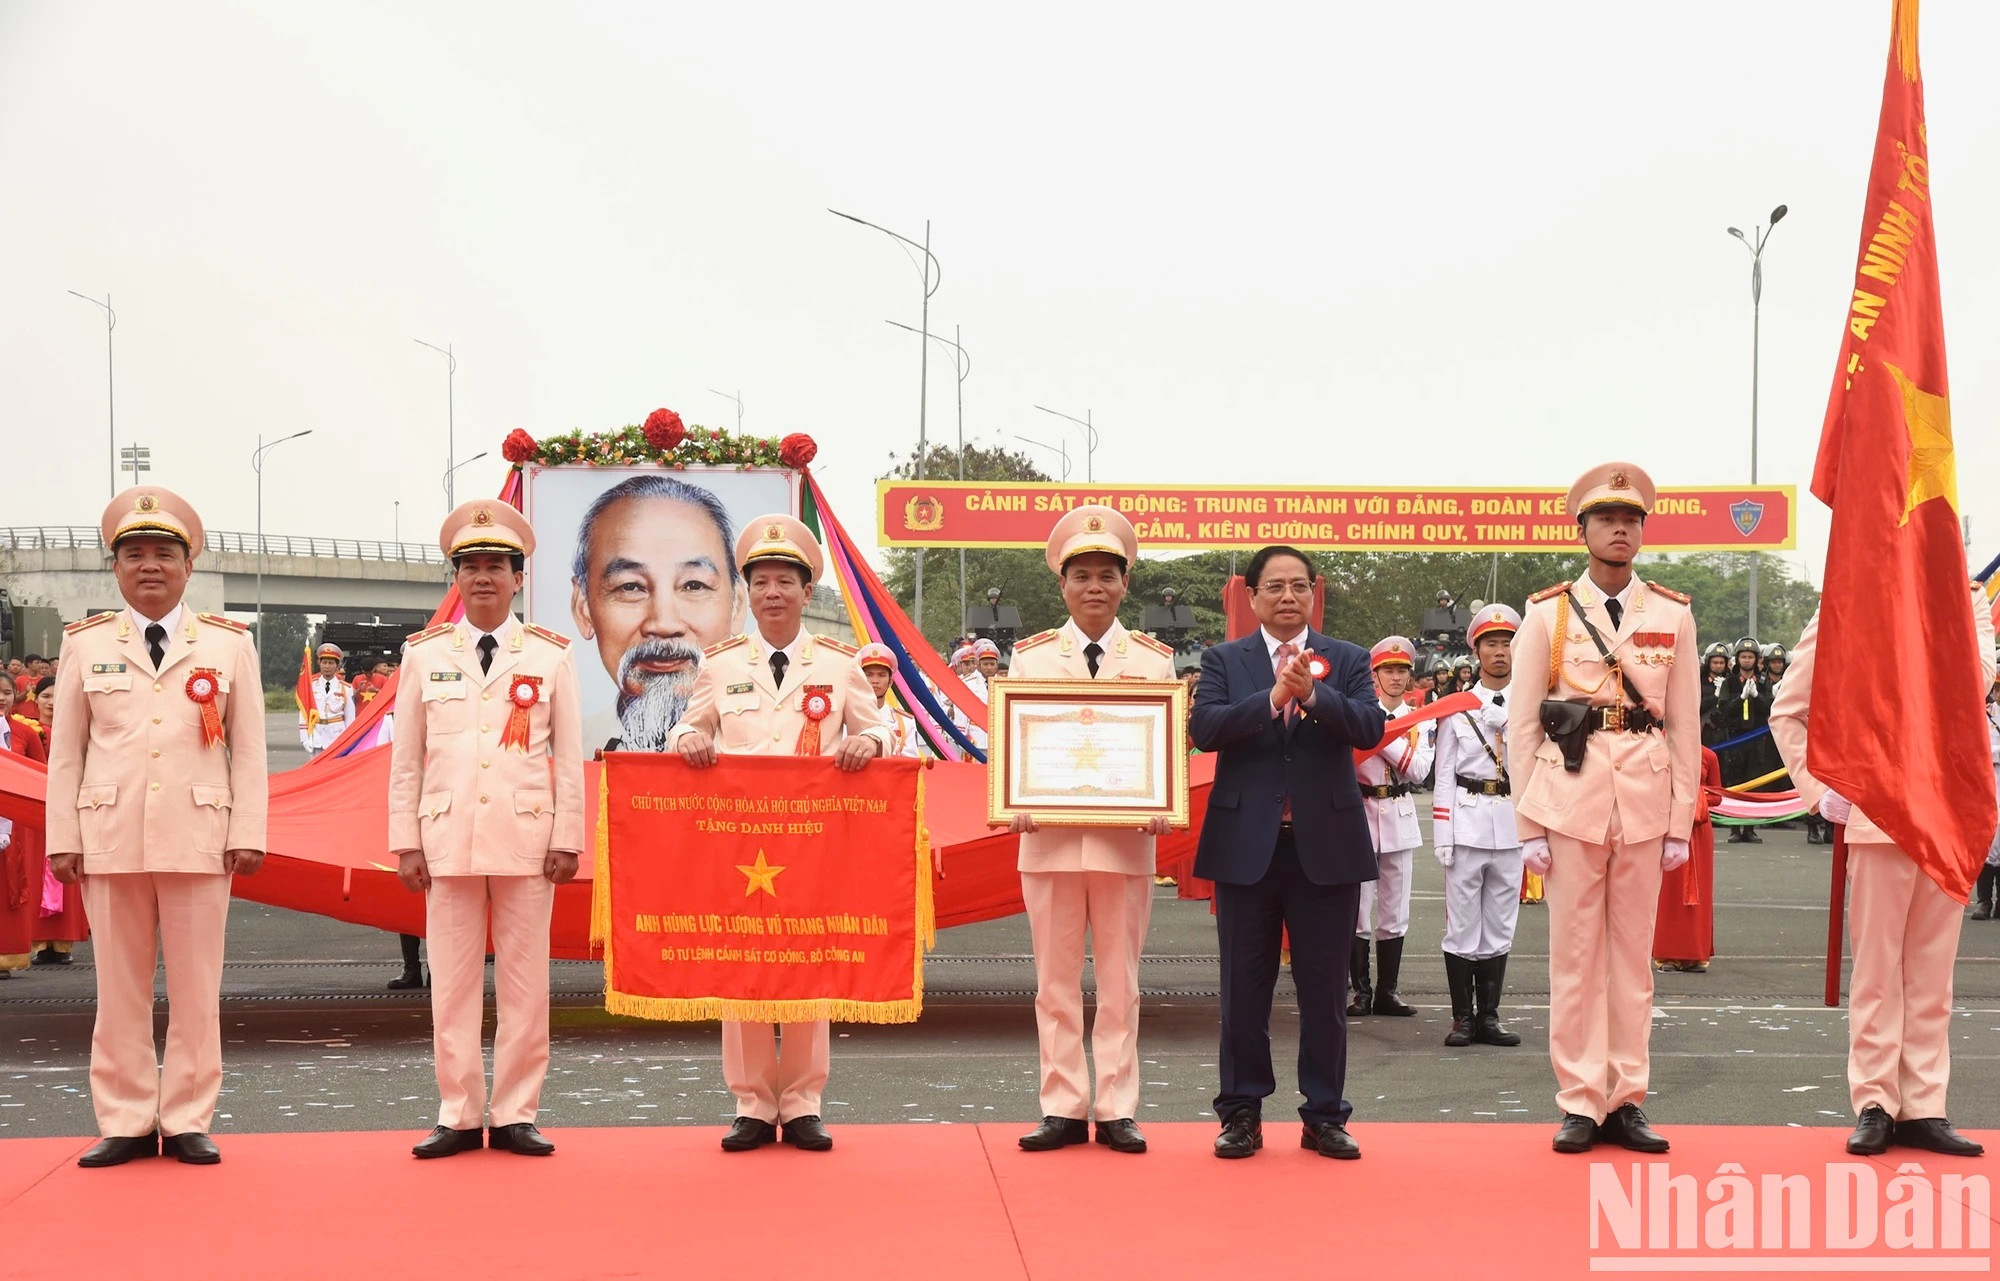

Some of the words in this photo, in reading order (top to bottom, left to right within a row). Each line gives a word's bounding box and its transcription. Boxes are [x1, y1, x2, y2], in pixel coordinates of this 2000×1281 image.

[1860, 200, 1919, 286] NINH
[1851, 289, 1887, 341] AN
[965, 491, 1026, 511] CẢNH
[1034, 493, 1076, 511] SÁT
[1119, 494, 1187, 515] ĐỘNG:
[1194, 497, 1267, 513] TRUNG
[1274, 495, 1347, 514] THÀNH
[1354, 496, 1390, 514] VỚI
[1396, 494, 1464, 516] ĐẢNG,
[1471, 496, 1532, 515] ĐOÀN
[1539, 495, 1567, 515] KẾ
[1648, 497, 1707, 516] ƠNG,
[1134, 518, 1191, 540] CẢM,
[1198, 520, 1250, 538] KIÊN
[1257, 520, 1340, 541] CƯỜNG,
[1347, 521, 1415, 540] CHÍNH
[1422, 524, 1468, 542] QUY,
[1475, 524, 1525, 540] TINH
[1532, 524, 1579, 540] NHU
[631, 791, 652, 810] CHỦ
[653, 797, 677, 813] TỊCH
[678, 793, 705, 810] NƯỚC
[706, 793, 733, 814] CỘNG
[735, 796, 755, 813] HÒA
[756, 796, 769, 813] XÃ
[771, 796, 788, 816] HỘI
[790, 795, 810, 813] CHỦ
[812, 795, 842, 812] NGHĨA
[843, 795, 866, 815] VIỆT
[866, 799, 888, 813] NAM
[696, 818, 737, 833] TẶNG
[741, 822, 783, 834] DANH
[788, 820, 823, 836] HIỆU
[636, 914, 660, 933] ANH
[662, 912, 697, 933] HÙNG
[699, 913, 722, 936] LỰC
[724, 915, 764, 938] LƯỢNG
[766, 913, 782, 935] VŨ
[784, 917, 825, 935] TRANG
[826, 912, 860, 934] NHÂN
[862, 914, 888, 935] DÂN
[662, 946, 675, 964] BỘ
[676, 948, 690, 961] TƯ
[691, 946, 714, 963] LỆNH
[716, 944, 742, 962] CẢNH
[744, 947, 761, 963] SÁT
[764, 950, 777, 963] CƠ
[779, 948, 809, 966] ĐỘNG,
[810, 947, 823, 966] BỘ
[825, 946, 850, 962] CÔNG
[851, 950, 865, 963] AN
